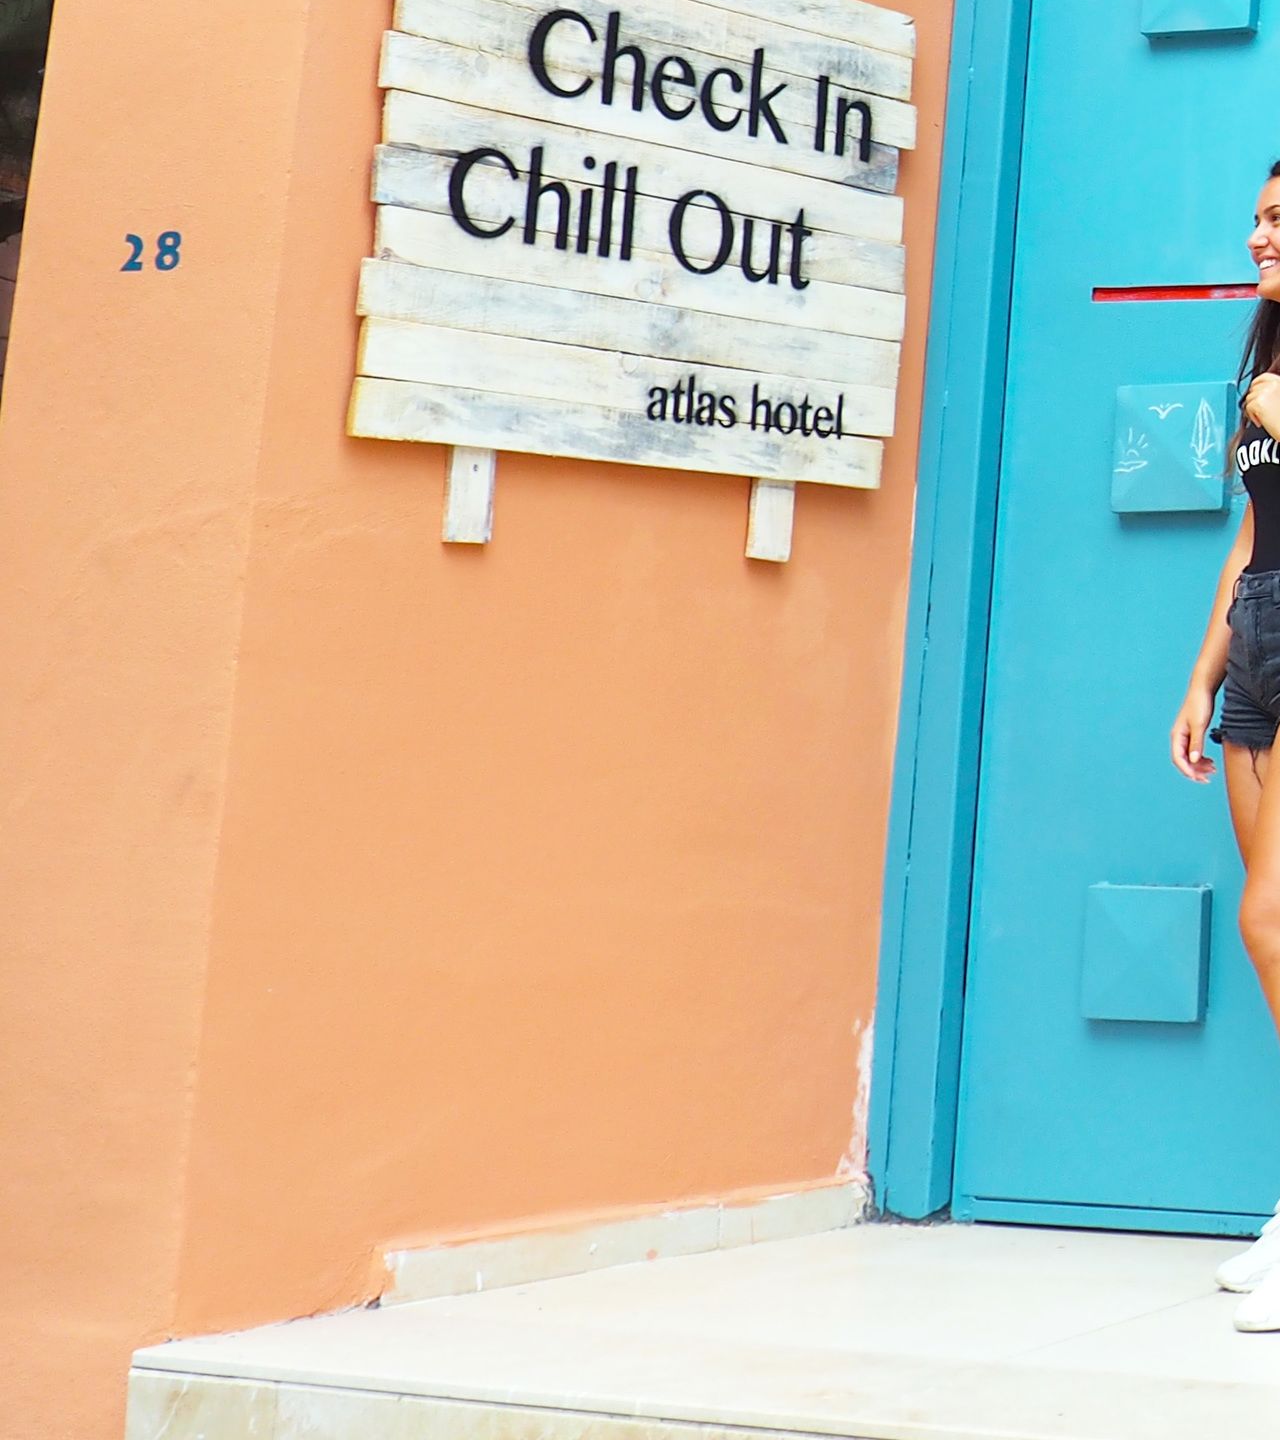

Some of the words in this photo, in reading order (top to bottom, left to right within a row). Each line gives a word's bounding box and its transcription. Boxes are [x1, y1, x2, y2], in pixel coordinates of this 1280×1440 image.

[527, 8, 789, 145] Check
[813, 75, 874, 163] In
[119, 230, 182, 272] 28
[447, 145, 640, 261] Chill
[668, 190, 815, 291] Out
[646, 373, 738, 429] atlas
[750, 383, 846, 441] hotel
